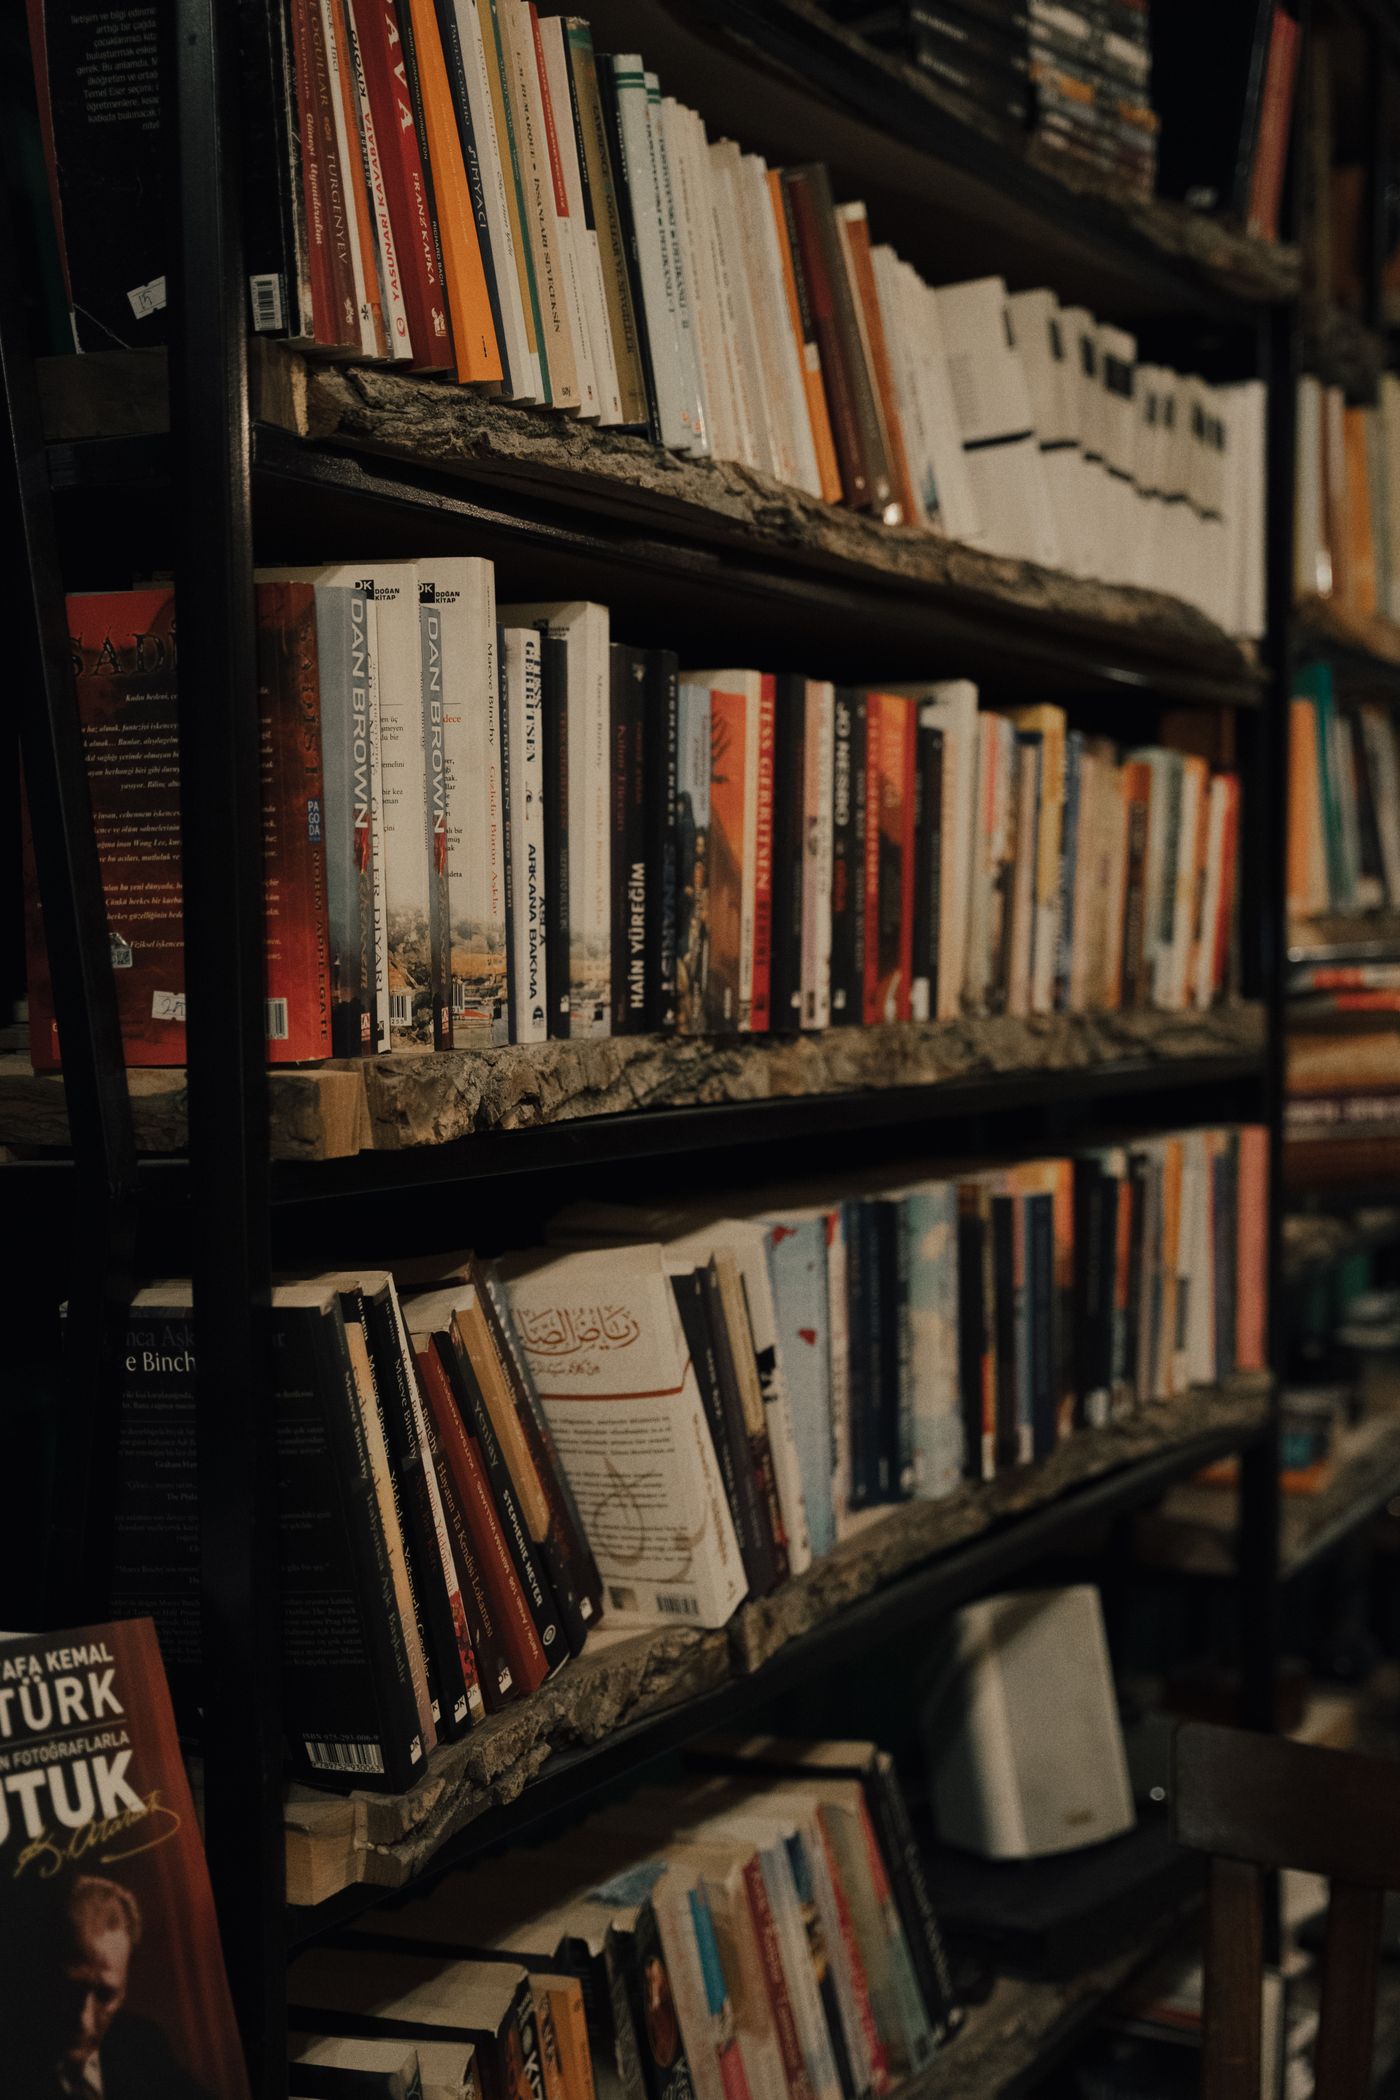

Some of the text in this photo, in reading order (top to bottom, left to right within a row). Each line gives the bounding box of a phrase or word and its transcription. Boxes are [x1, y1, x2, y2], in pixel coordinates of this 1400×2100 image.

[450, 23, 461, 66] PAULO
[456, 67, 471, 126] COELHO
[519, 82, 534, 159] REMARQUE
[325, 151, 348, 265] TURGENYEV
[363, 111, 384, 207] KAVABATA
[412, 172, 428, 228] FRANZ
[422, 231, 436, 285] KAFKA
[432, 220, 440, 260] RICHARD
[435, 590, 460, 598] DOĞAN
[352, 600, 369, 828] DAN BROWN
[428, 617, 446, 833] DAN BROWN
[526, 641, 536, 762] GERRITSEN
[668, 674, 676, 752] THOMAS
[761, 702, 774, 746] TESS
[308, 800, 318, 812] PA
[308, 812, 320, 824] GO
[308, 824, 320, 836] DA
[756, 758, 774, 890] GERRITSEN
[312, 851, 328, 1042] NORM APPLEGATE
[528, 844, 538, 1000] ARKANA BAKMA
[628, 862, 646, 1009] HAİN YÜREĞİM
[143, 1351, 198, 1372] Binch
[368, 1353, 381, 1403] Maeve
[377, 1406, 390, 1458] Binchy
[394, 1358, 408, 1407] Maeve
[401, 1409, 418, 1460] Binchy
[343, 1370, 358, 1422] Maeve
[352, 1426, 369, 1480] Binchy
[420, 1406, 494, 1639] Binchy Hayatın Ta Kendisi Lokantası
[476, 1480, 496, 1531] WILLIAMS
[502, 1488, 543, 1607] STEPHENIE MEYER
[46, 1642, 114, 1672] KEMAL
[0, 1750, 146, 1846] TUK
[13, 1731, 130, 1769] FOTOĞRAFLARLA
